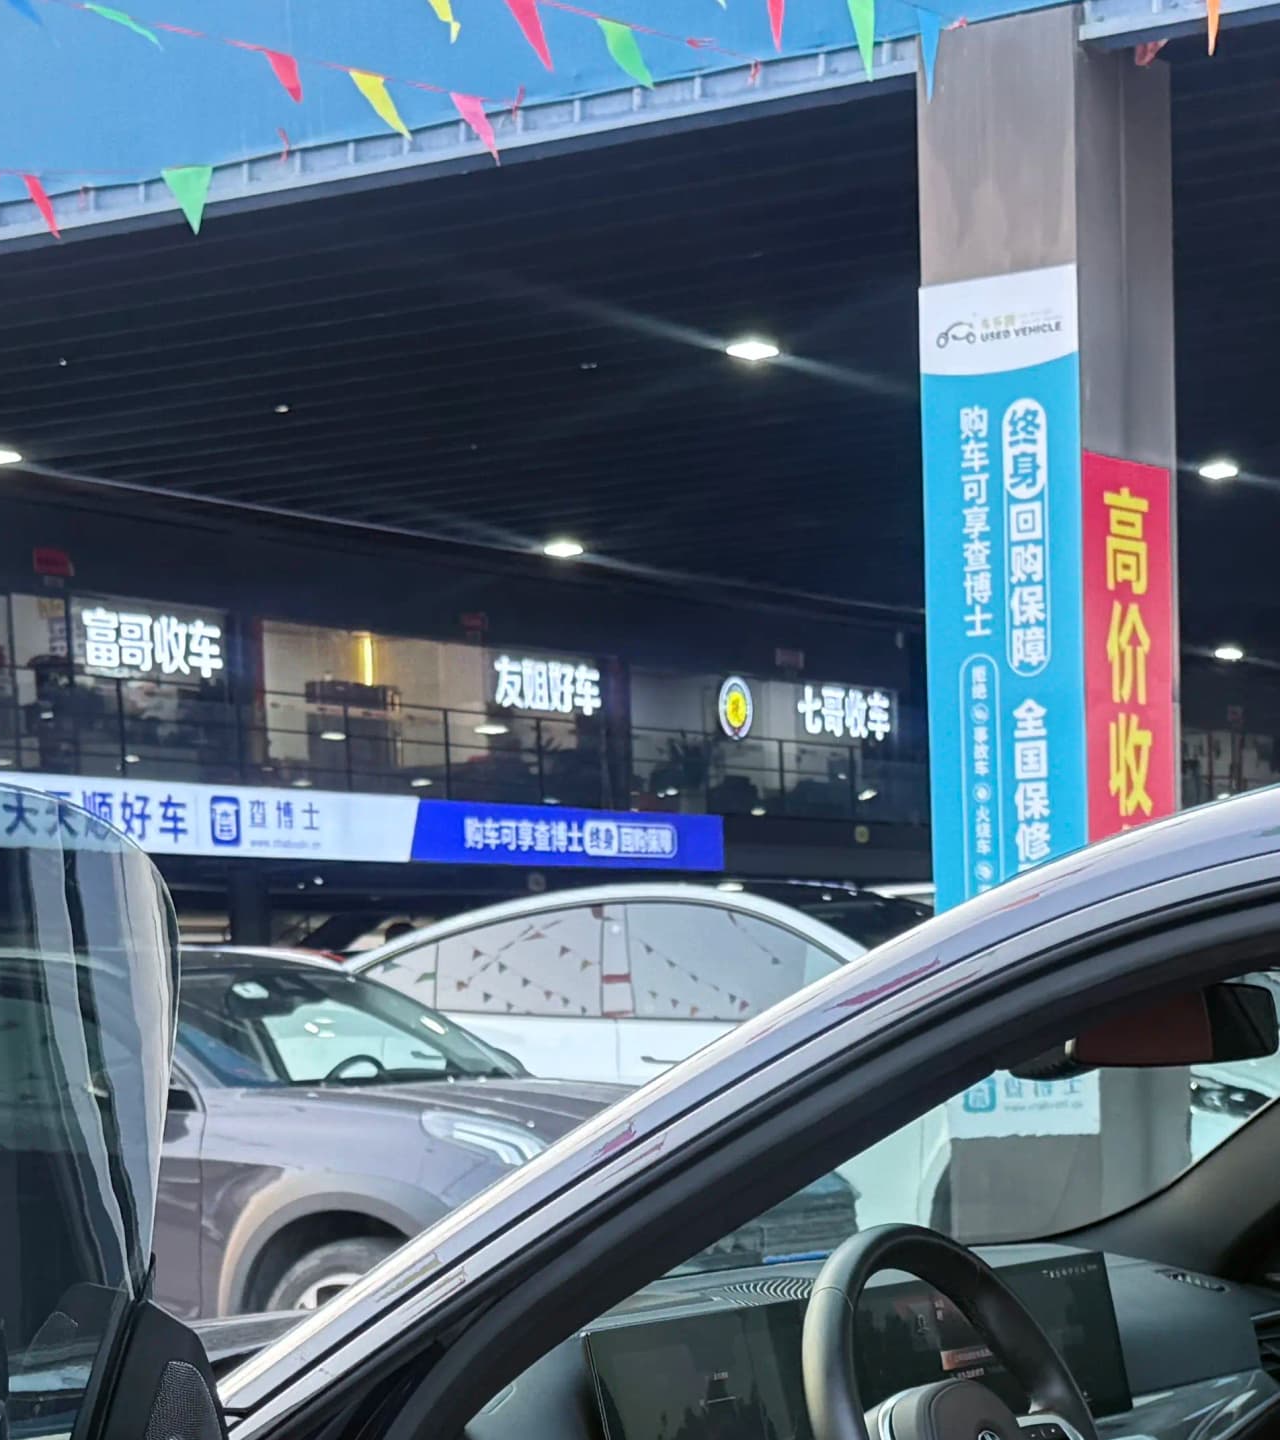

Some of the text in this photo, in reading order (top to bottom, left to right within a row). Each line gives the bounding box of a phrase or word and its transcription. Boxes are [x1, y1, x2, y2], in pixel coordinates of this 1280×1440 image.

[1013, 321, 1062, 338] VEHICLE
[959, 405, 993, 637] 购车可享查博士
[81, 606, 224, 678] 富哥收车
[1007, 408, 1051, 870] 终身回购保障 全国保修
[1104, 487, 1152, 831] 高价收
[494, 655, 602, 716] 友姐好车
[797, 684, 891, 742] 七哥收车
